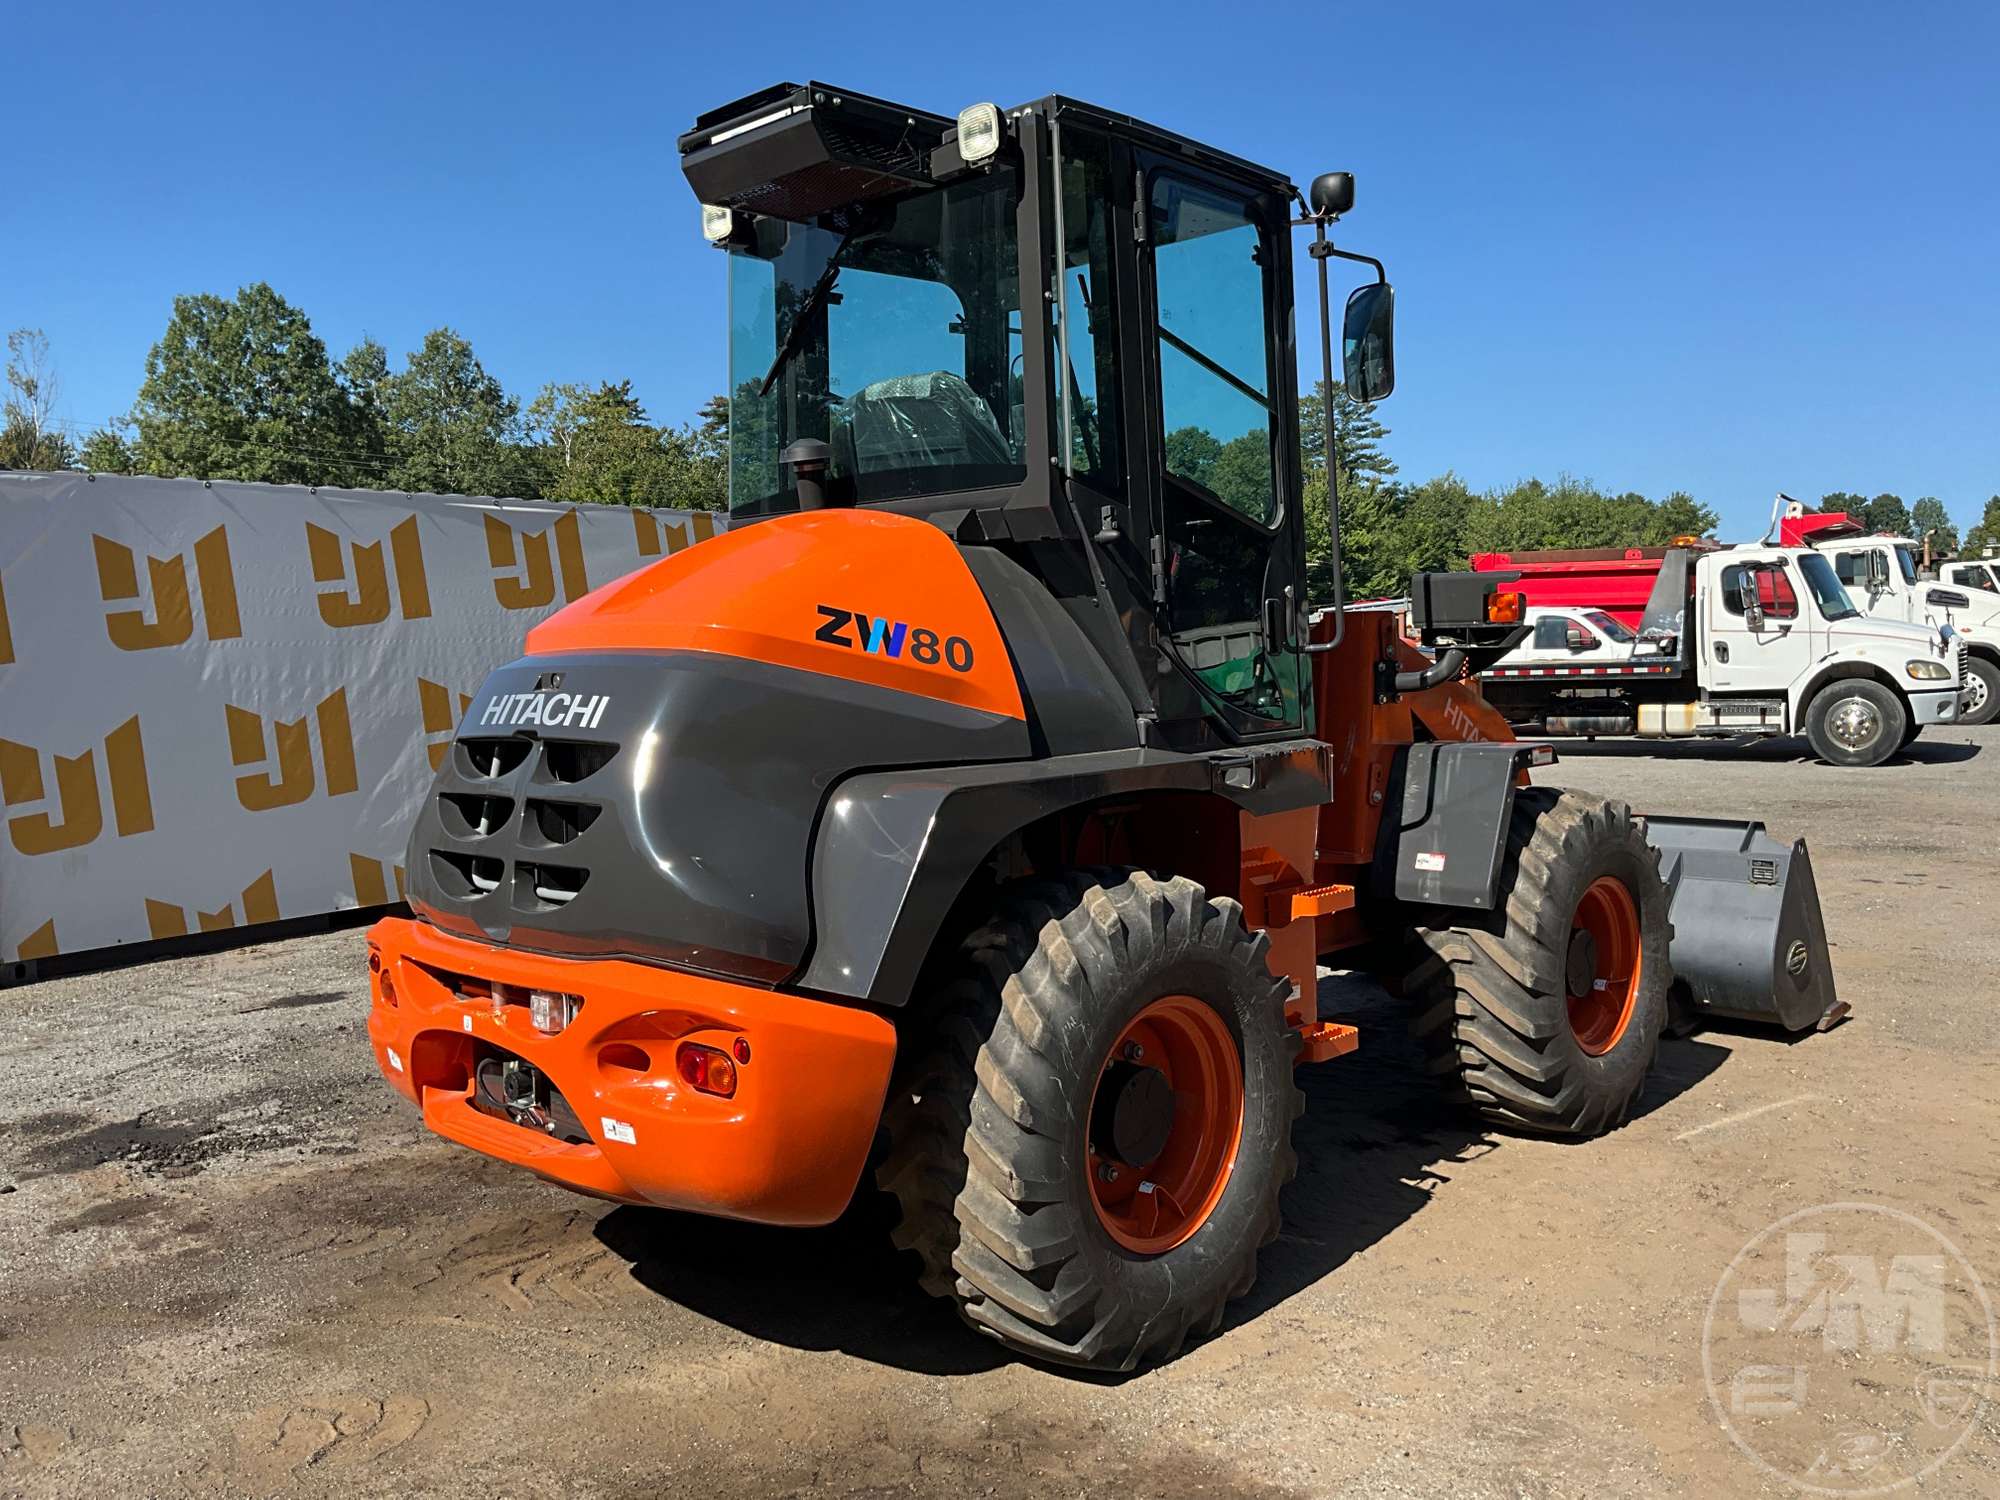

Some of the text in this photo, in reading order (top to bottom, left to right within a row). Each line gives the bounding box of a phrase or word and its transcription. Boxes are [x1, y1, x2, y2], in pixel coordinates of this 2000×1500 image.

[815, 604, 975, 673] ZW80
[480, 693, 610, 728] HITACHI
[1443, 696, 1489, 742] HITA
